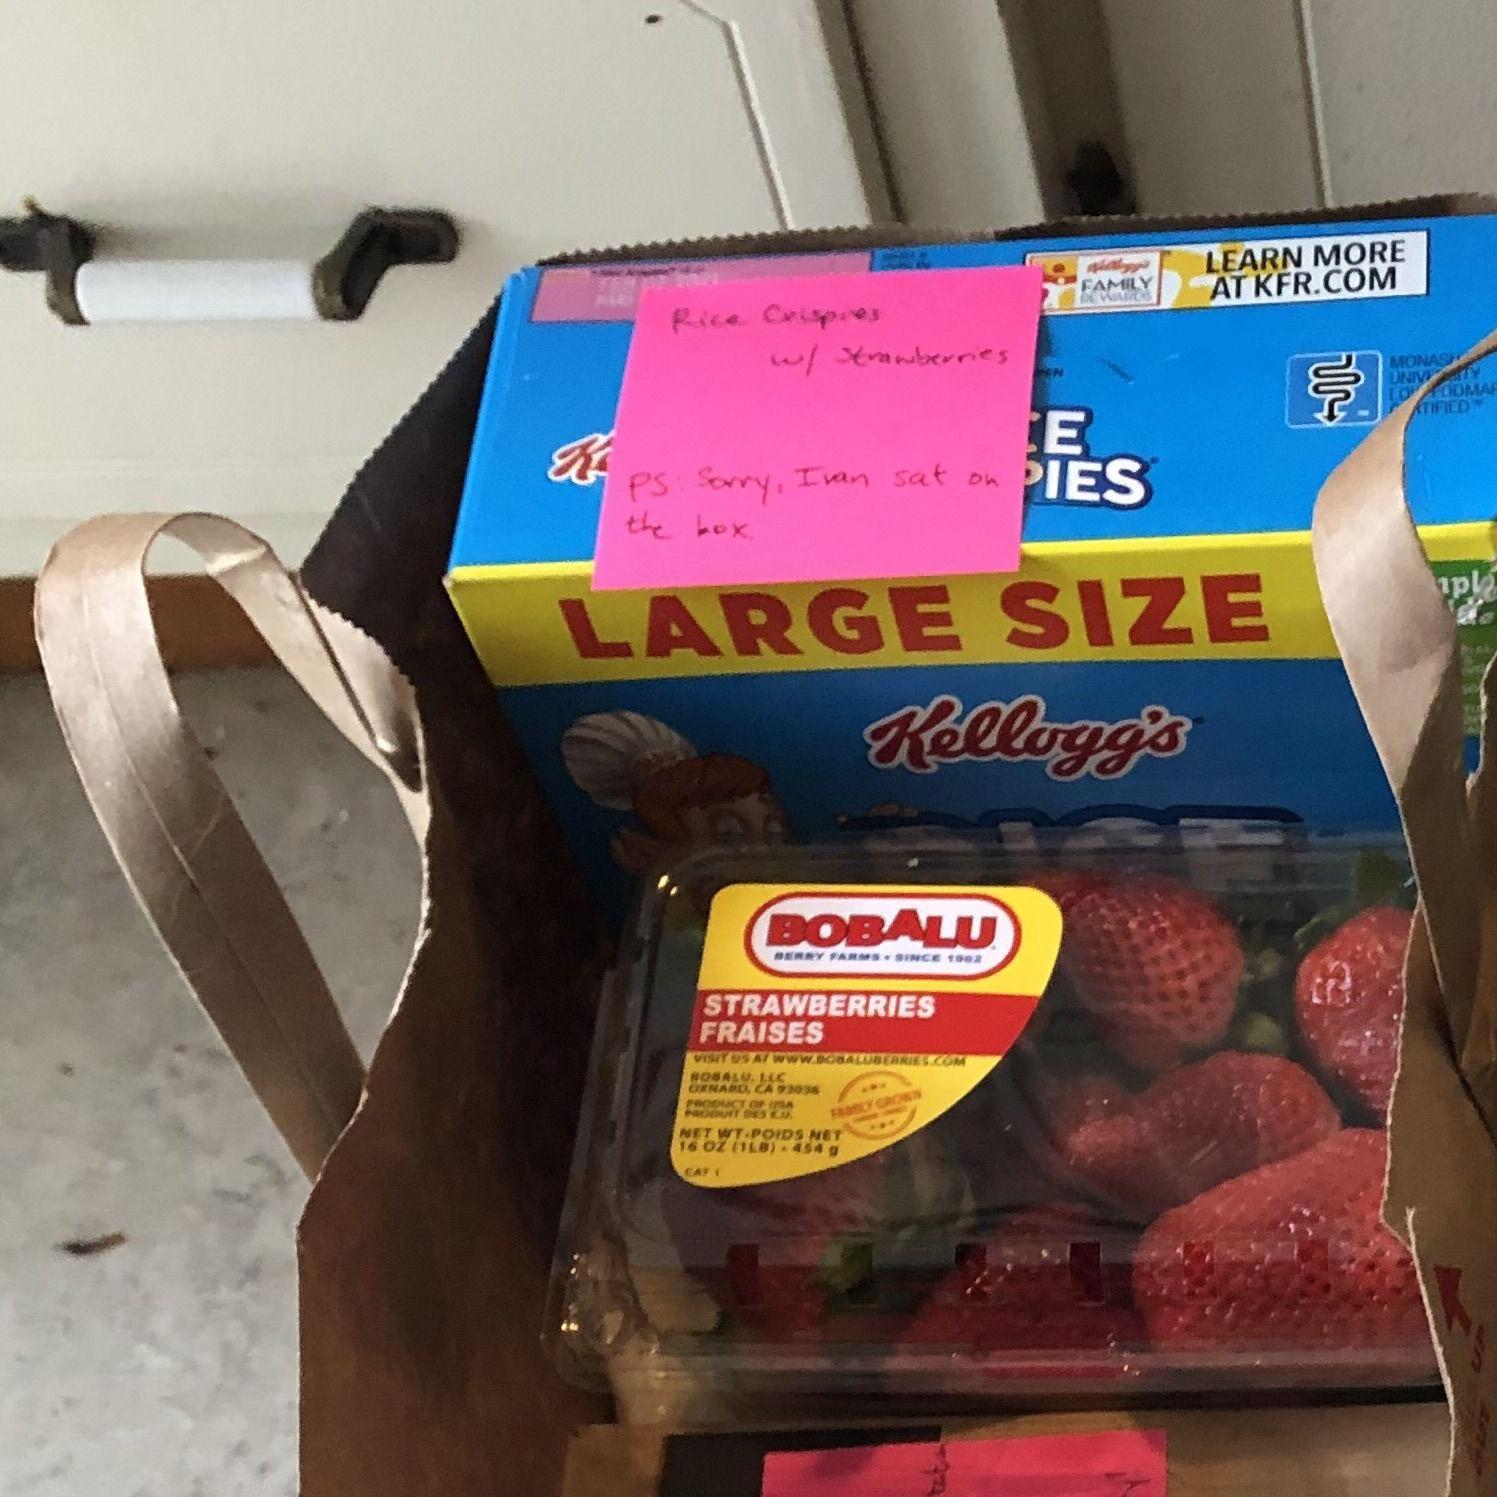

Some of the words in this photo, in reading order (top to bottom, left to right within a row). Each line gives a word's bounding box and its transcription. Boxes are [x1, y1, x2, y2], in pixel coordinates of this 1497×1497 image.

[1206, 246, 1302, 274] LEARN
[1314, 240, 1405, 267] MORE
[1081, 276, 1153, 292] FAMILY
[1210, 275, 1246, 301] AT
[1254, 266, 1397, 298] KFR.COM
[671, 307, 747, 334] Rice
[895, 463, 947, 487] sat
[968, 471, 1000, 488] on
[627, 511, 671, 541] the
[558, 583, 962, 662] LARGE
[1000, 573, 1271, 650] SIZE
[866, 697, 1190, 779] Kellogg's
[766, 909, 998, 949] BOBALU
[774, 952, 824, 961] BERRY
[829, 952, 880, 962] FARMS
[895, 953, 941, 963] SINCE
[703, 994, 936, 1018] STRAWBERRIES
[699, 1021, 824, 1044] FRAISES
[694, 1053, 728, 1064] VISIT
[731, 1054, 749, 1064] US
[753, 1054, 769, 1064] AT
[755, 1085, 773, 1095] CA
[760, 1073, 785, 1083] LLC
[679, 1128, 712, 1139] NET
[809, 1129, 842, 1141] NET
[679, 1141, 697, 1152] 16
[703, 1142, 727, 1153] OZ
[792, 1143, 823, 1154] 454
[828, 1144, 839, 1157] g
